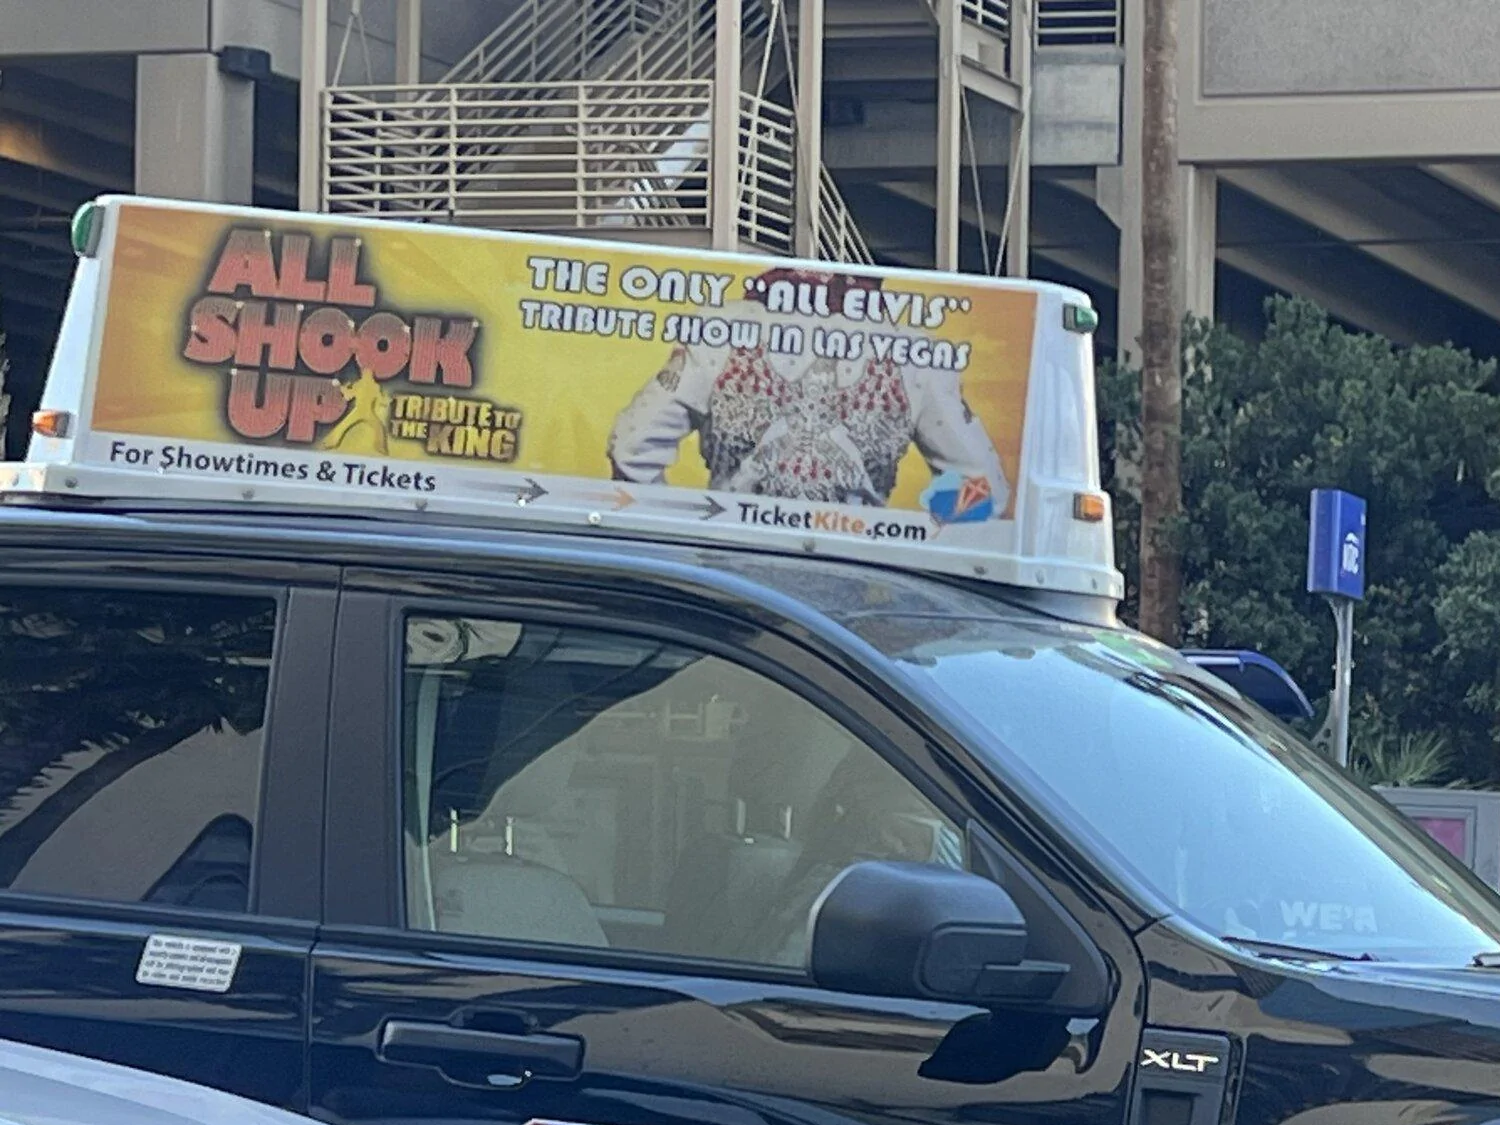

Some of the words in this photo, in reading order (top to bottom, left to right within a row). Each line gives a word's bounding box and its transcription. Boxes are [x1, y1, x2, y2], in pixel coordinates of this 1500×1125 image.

[207, 229, 377, 307] ALL
[528, 257, 609, 296] THE
[620, 265, 735, 307] ONLY
[743, 276, 831, 318] "ALL
[842, 287, 972, 329] ELVIS"
[184, 296, 479, 387] SHOOK
[520, 299, 656, 341] TRIBUTE
[661, 313, 762, 349] SHOW
[768, 323, 804, 355] IN
[813, 326, 866, 361] LAS
[869, 333, 972, 372] VEGAS
[227, 370, 349, 442] UP
[391, 394, 493, 428] TRIBUTE
[493, 409, 521, 429] TO
[109, 441, 154, 465] For
[160, 445, 309, 481] Showtimes
[316, 459, 337, 483] &
[342, 462, 437, 492] Tickets
[389, 419, 428, 439] THE
[426, 422, 517, 460] KING
[737, 501, 928, 541] TicketKite.com
[1141, 1049, 1219, 1072] XLT
